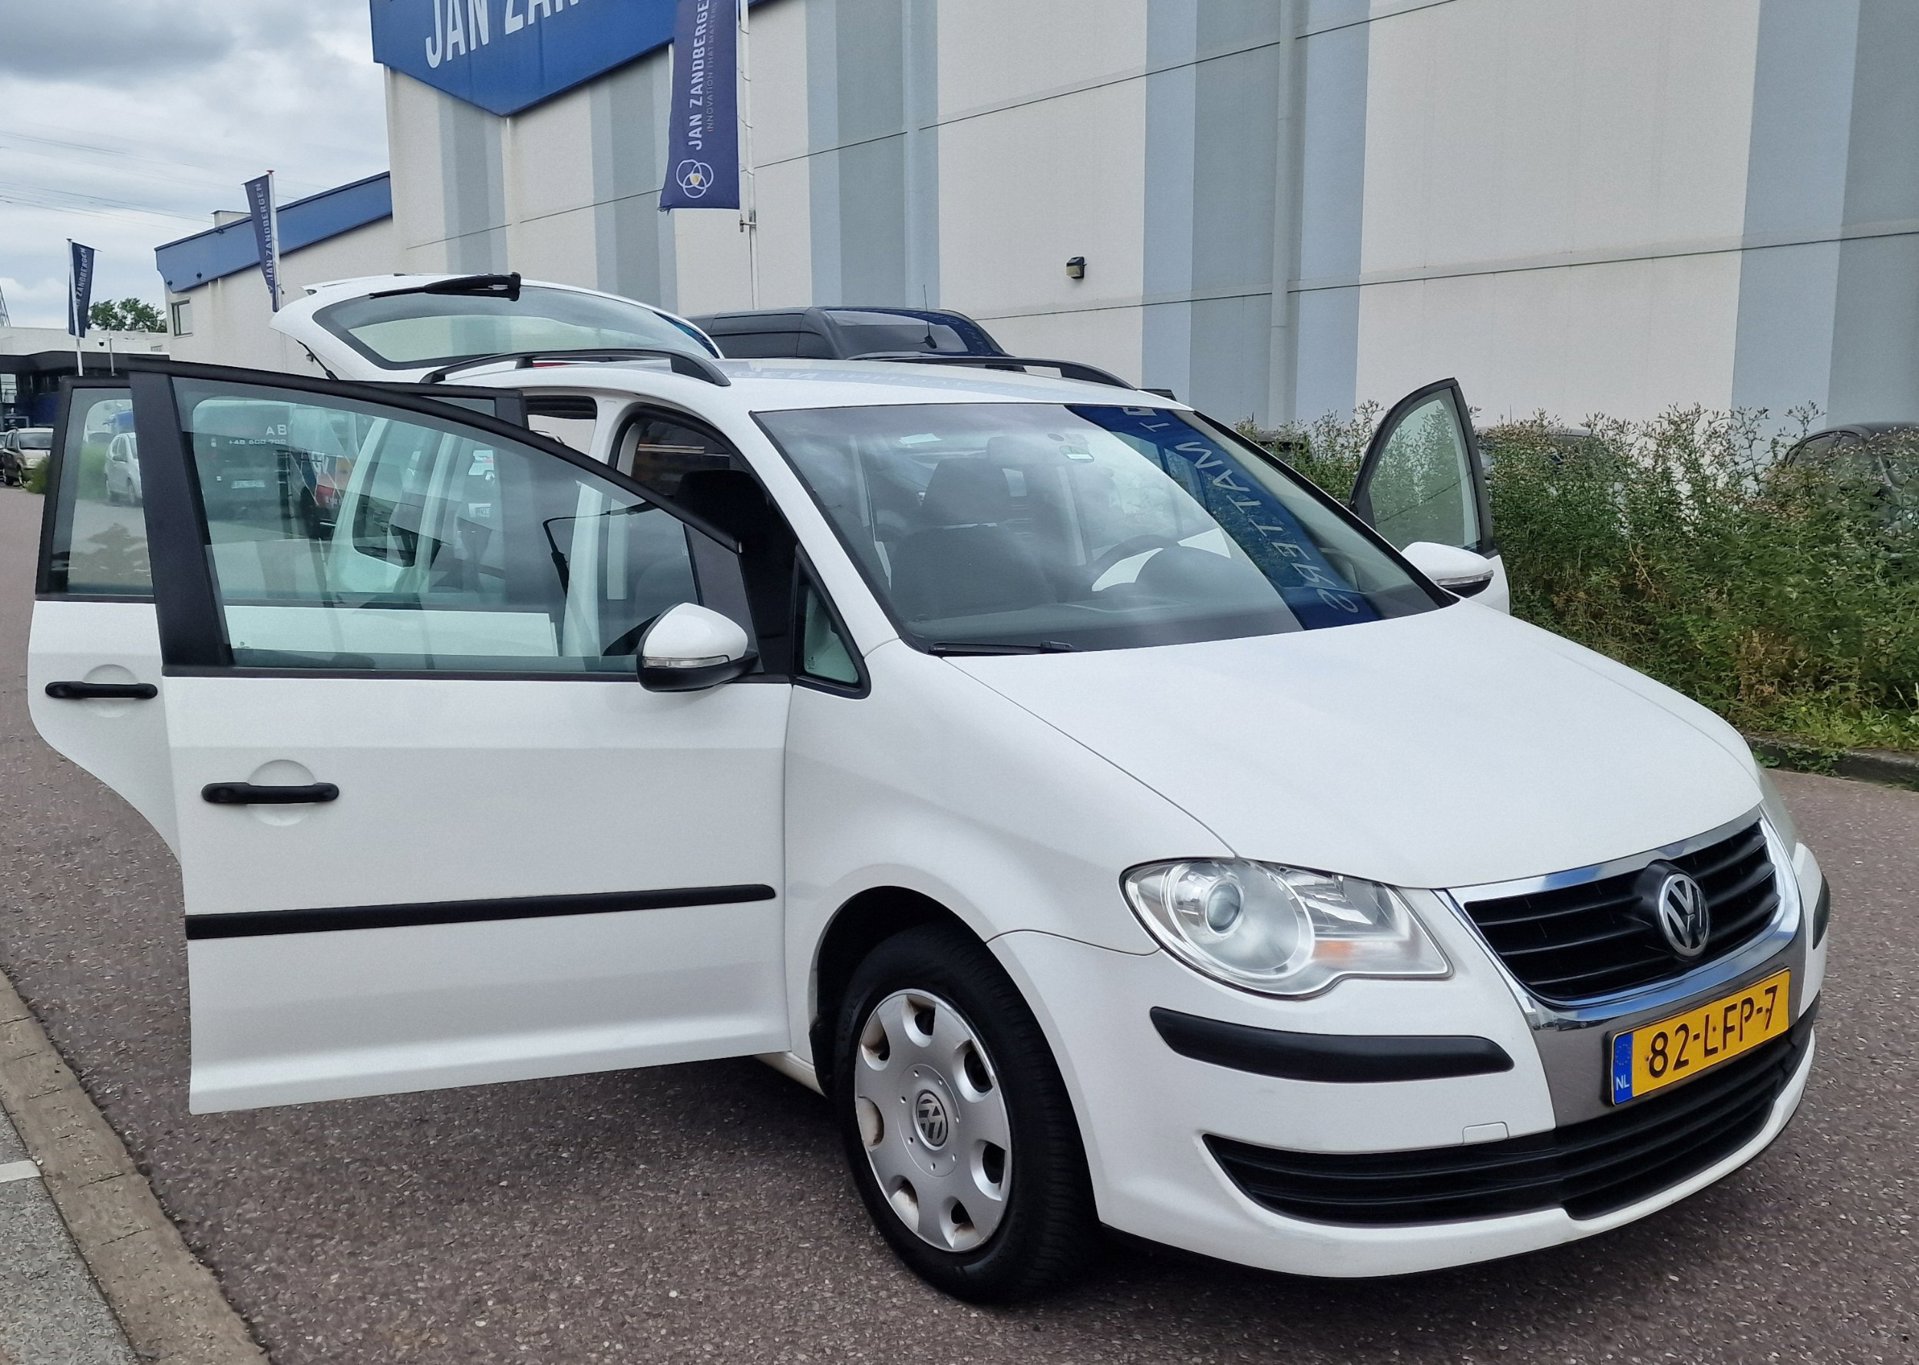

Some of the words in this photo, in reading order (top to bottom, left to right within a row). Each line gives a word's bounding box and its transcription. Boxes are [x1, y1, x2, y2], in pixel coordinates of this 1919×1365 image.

[426, 0, 489, 69] JAN
[689, 0, 710, 109] ZANDBERGE
[688, 113, 703, 151] JAN
[706, 72, 714, 132] INNOVATION
[255, 183, 274, 257] ZANDBERGEN
[1648, 984, 1779, 1079] 82-LFP-7
[1615, 1074, 1631, 1092] NL
